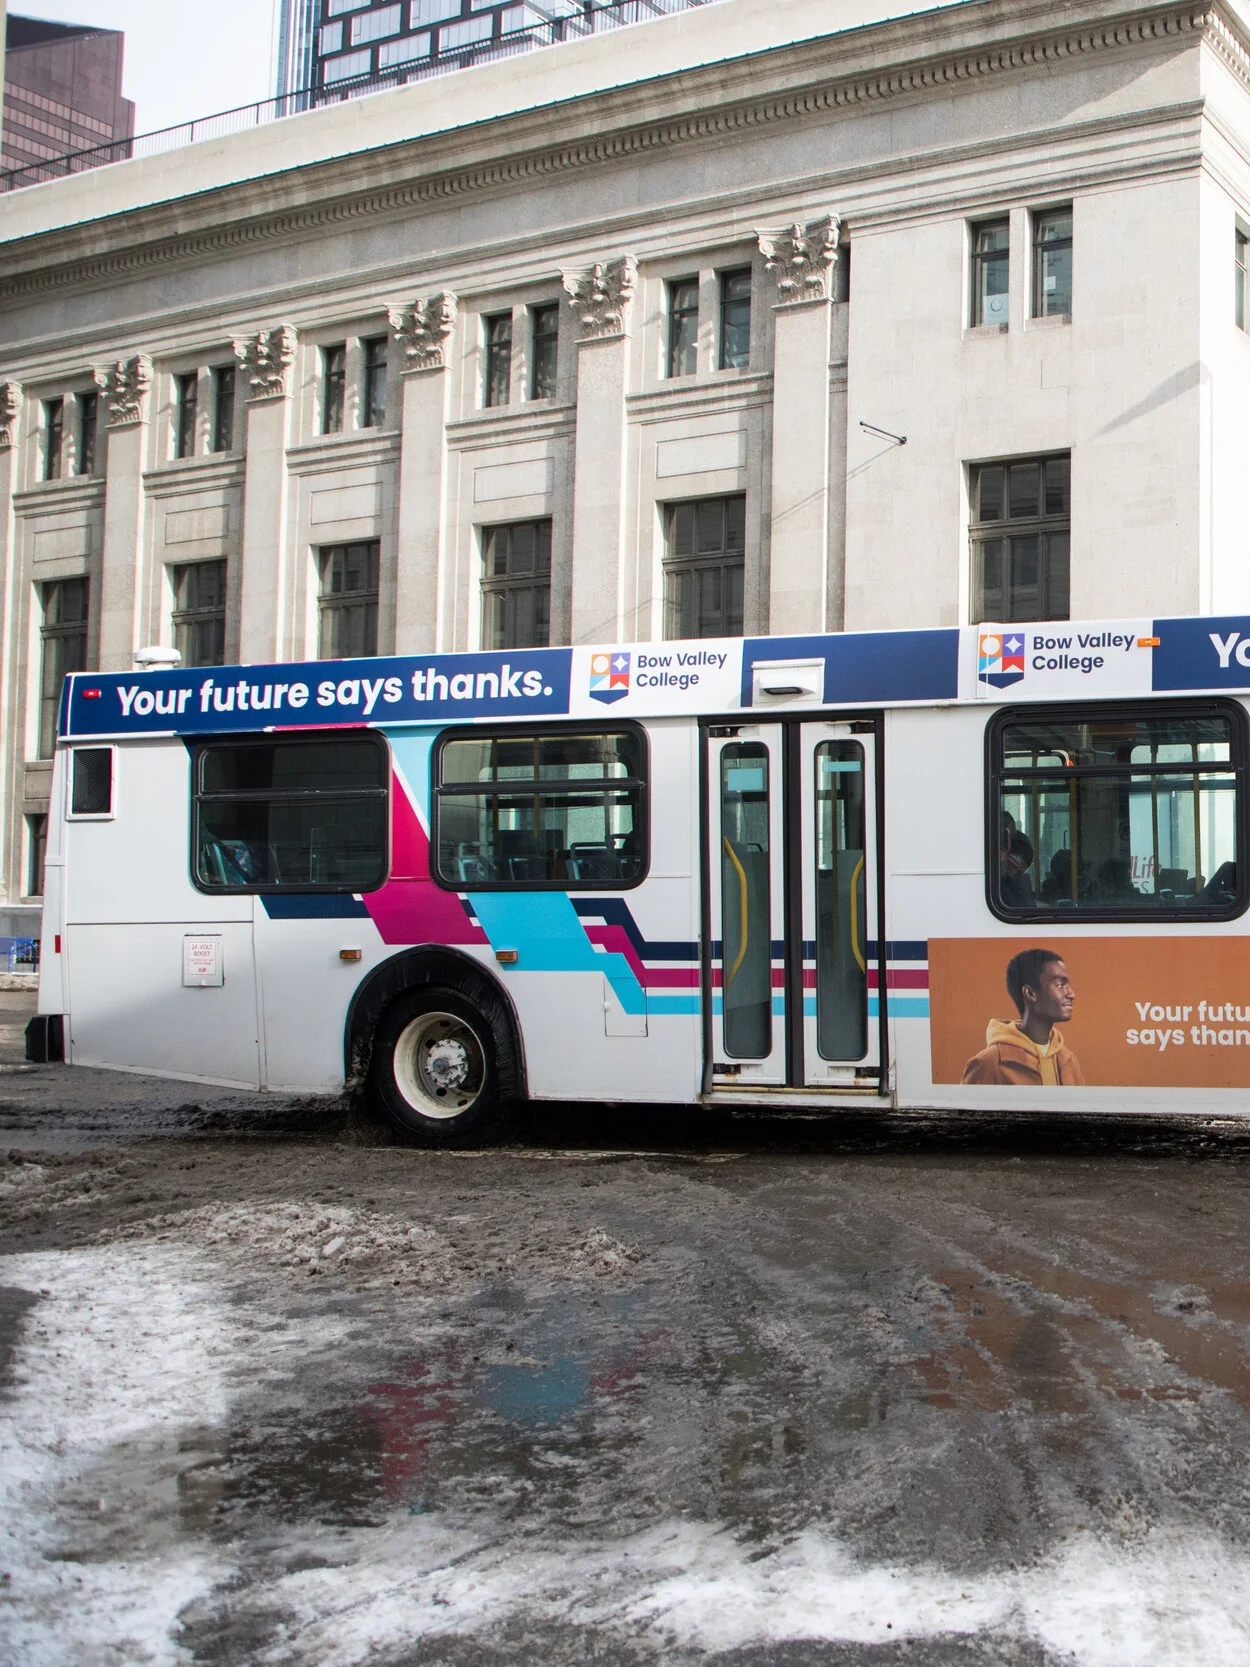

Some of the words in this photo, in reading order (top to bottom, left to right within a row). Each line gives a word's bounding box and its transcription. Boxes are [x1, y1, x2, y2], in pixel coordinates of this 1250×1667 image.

[1033, 636, 1073, 651] Bow
[1078, 632, 1135, 652] Valley
[637, 655, 673, 669] Bow
[676, 651, 728, 669] Valley
[1032, 654, 1105, 673] College
[117, 682, 192, 716] Your
[200, 679, 309, 713] future
[316, 676, 403, 707] says
[411, 664, 554, 701] thanks.
[636, 671, 700, 691] College
[1134, 1002, 1193, 1023] Your
[1126, 1028, 1185, 1052] says
